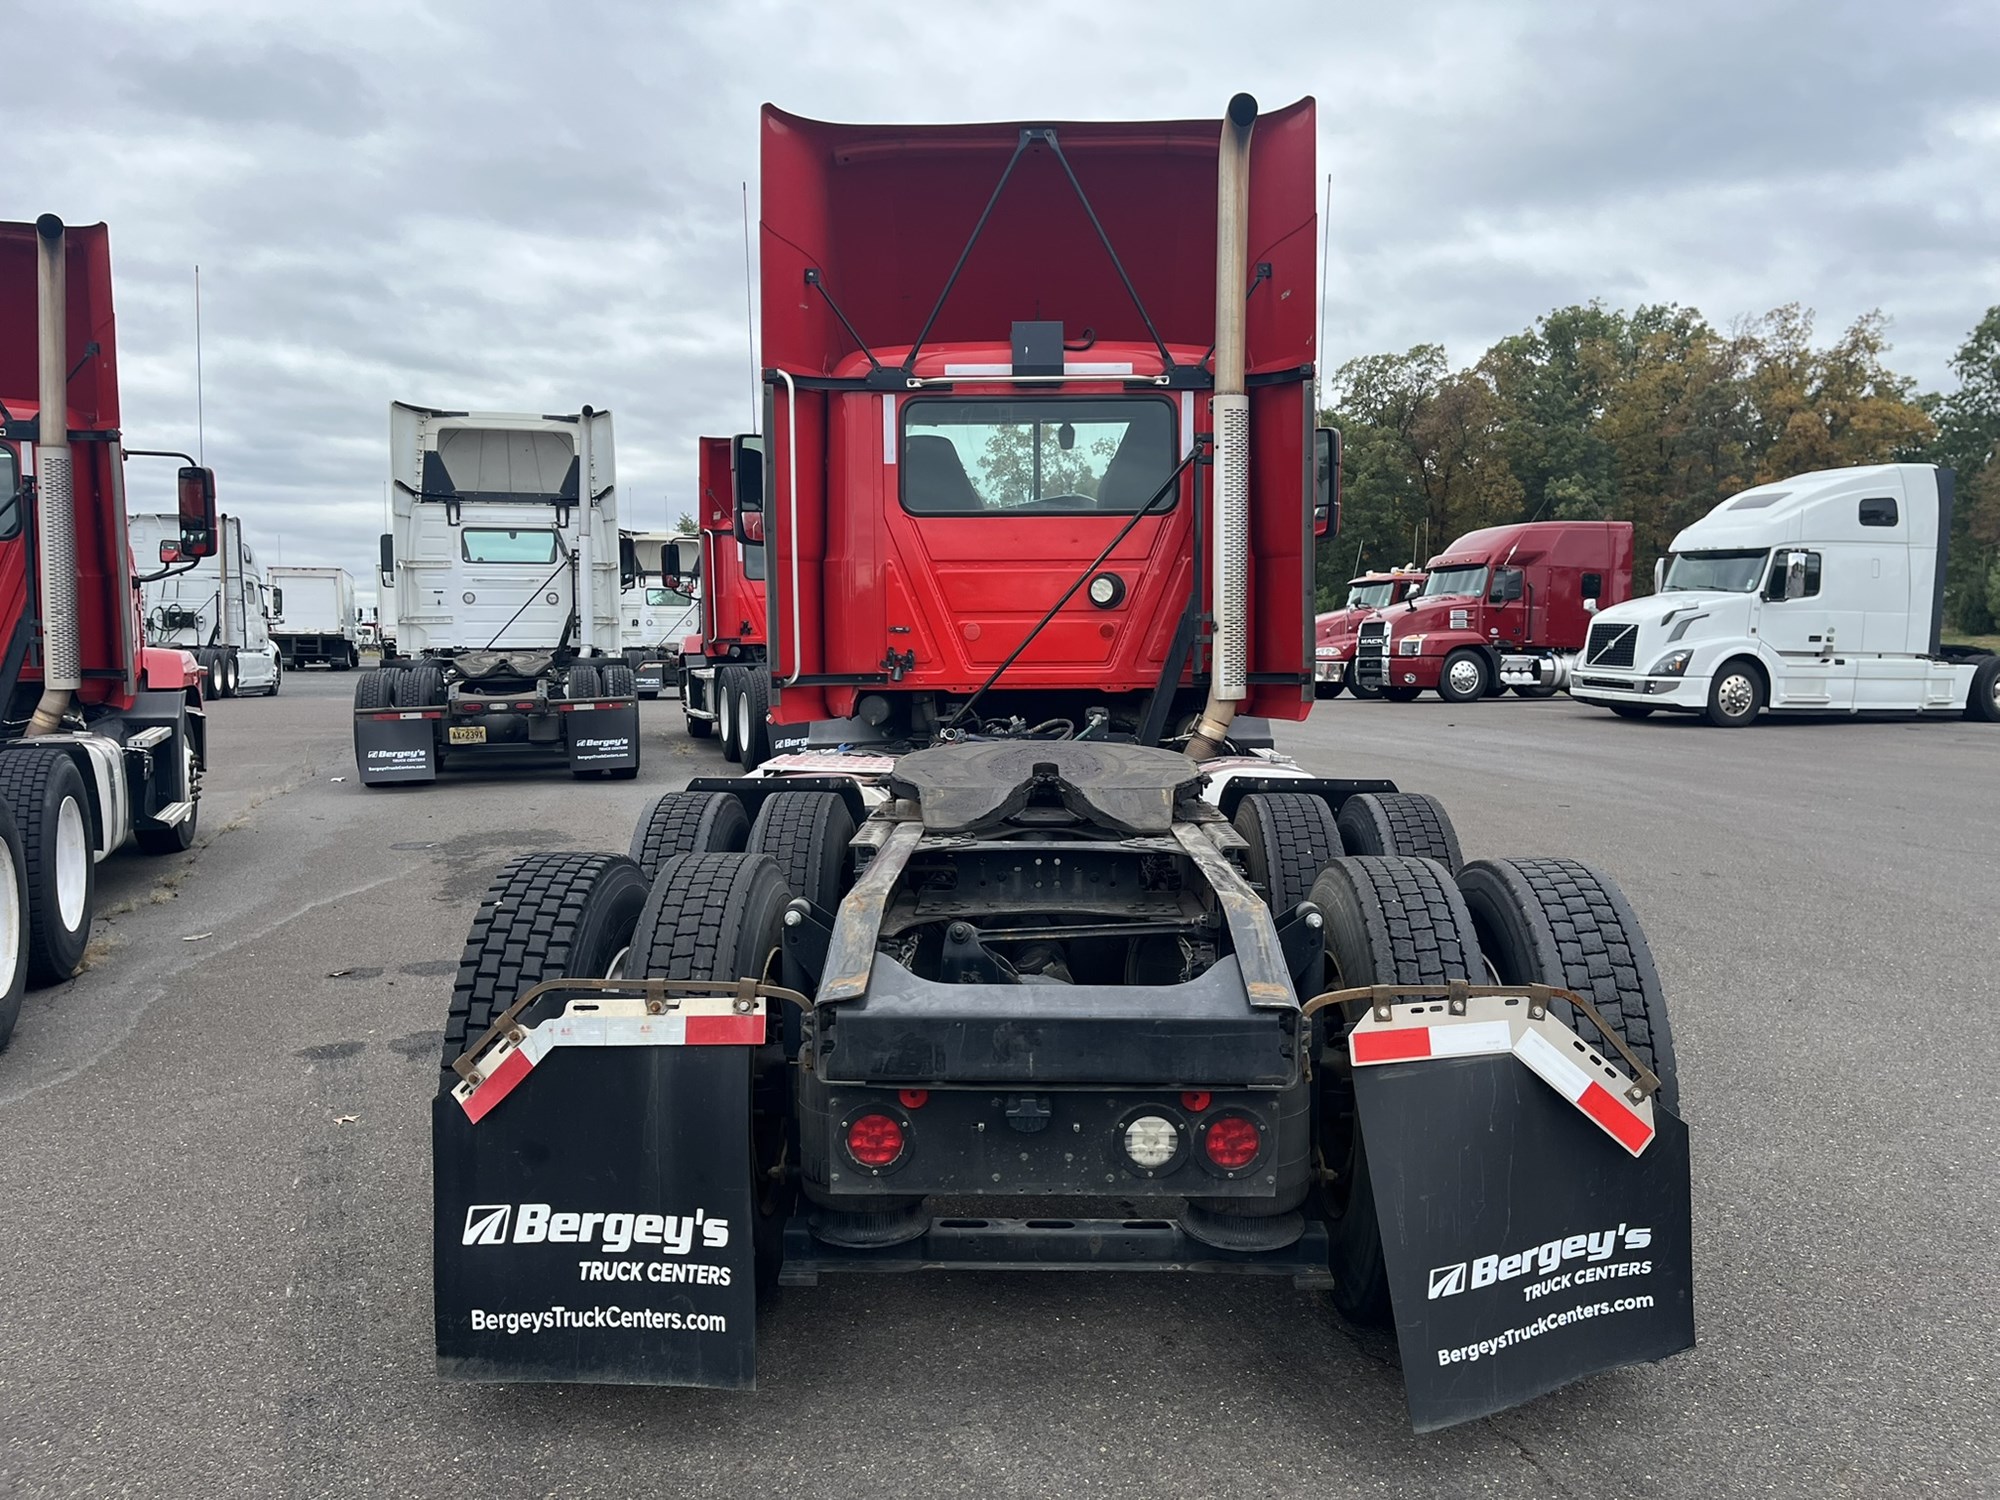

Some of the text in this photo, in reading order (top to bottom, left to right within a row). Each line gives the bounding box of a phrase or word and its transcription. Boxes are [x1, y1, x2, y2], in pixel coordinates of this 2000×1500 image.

[378, 749, 426, 758] Bergey's
[586, 738, 628, 746] Bergey's
[513, 1204, 729, 1254] Bergey's
[578, 1261, 732, 1287] TRUCK CENTERS
[1470, 1223, 1652, 1290] Bergey's
[1523, 1260, 1653, 1302] TRUCK CENTERS
[471, 1305, 726, 1334] BergeysTruckCenters.com
[1437, 1293, 1654, 1367] BergeysTruckCenters.com
